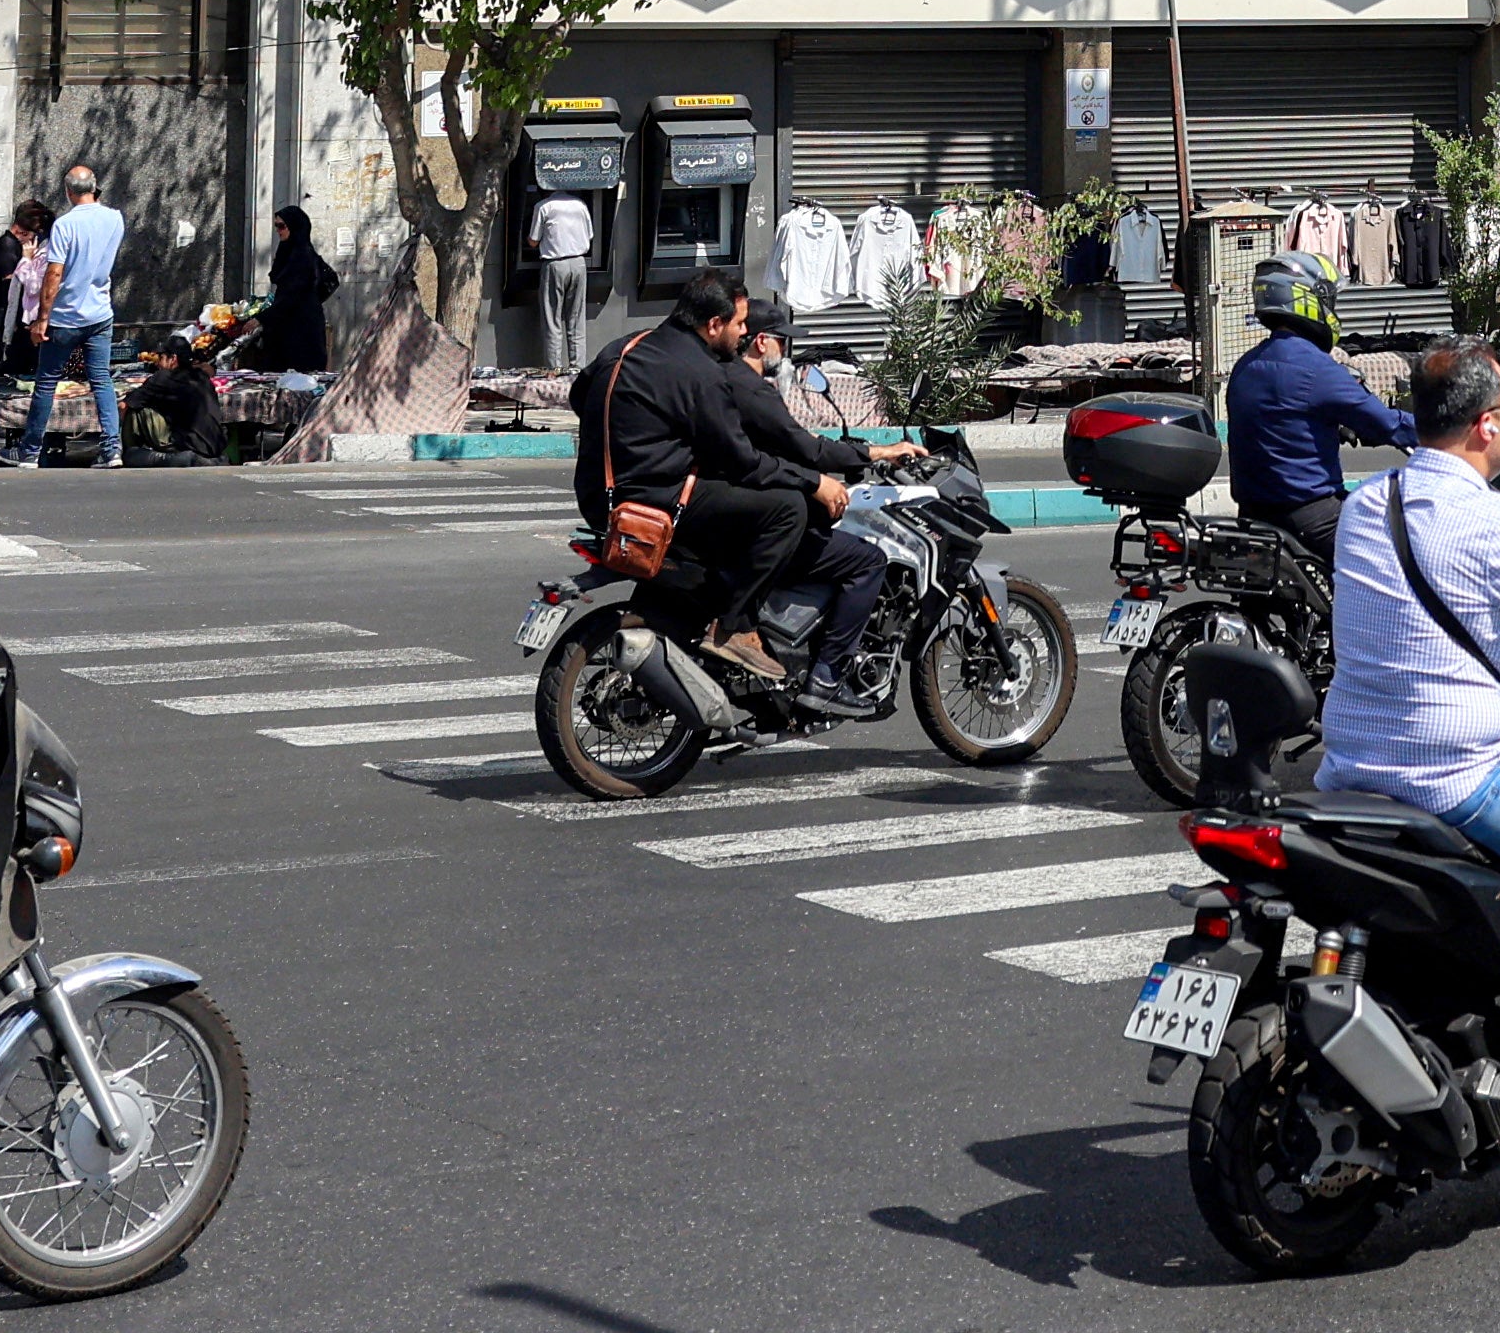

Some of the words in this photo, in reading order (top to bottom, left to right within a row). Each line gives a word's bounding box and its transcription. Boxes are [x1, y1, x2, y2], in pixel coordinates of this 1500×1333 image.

[564, 100, 583, 109] Melli
[583, 100, 600, 109] Iran
[678, 97, 696, 107] Bank
[696, 97, 715, 106] Melli
[715, 96, 731, 106] Iran
[1127, 604, 1150, 622] ۱۶۵
[1173, 974, 1217, 1009] ۱۶۵
[1133, 1006, 1214, 1049] ۴۳۶۲۹
